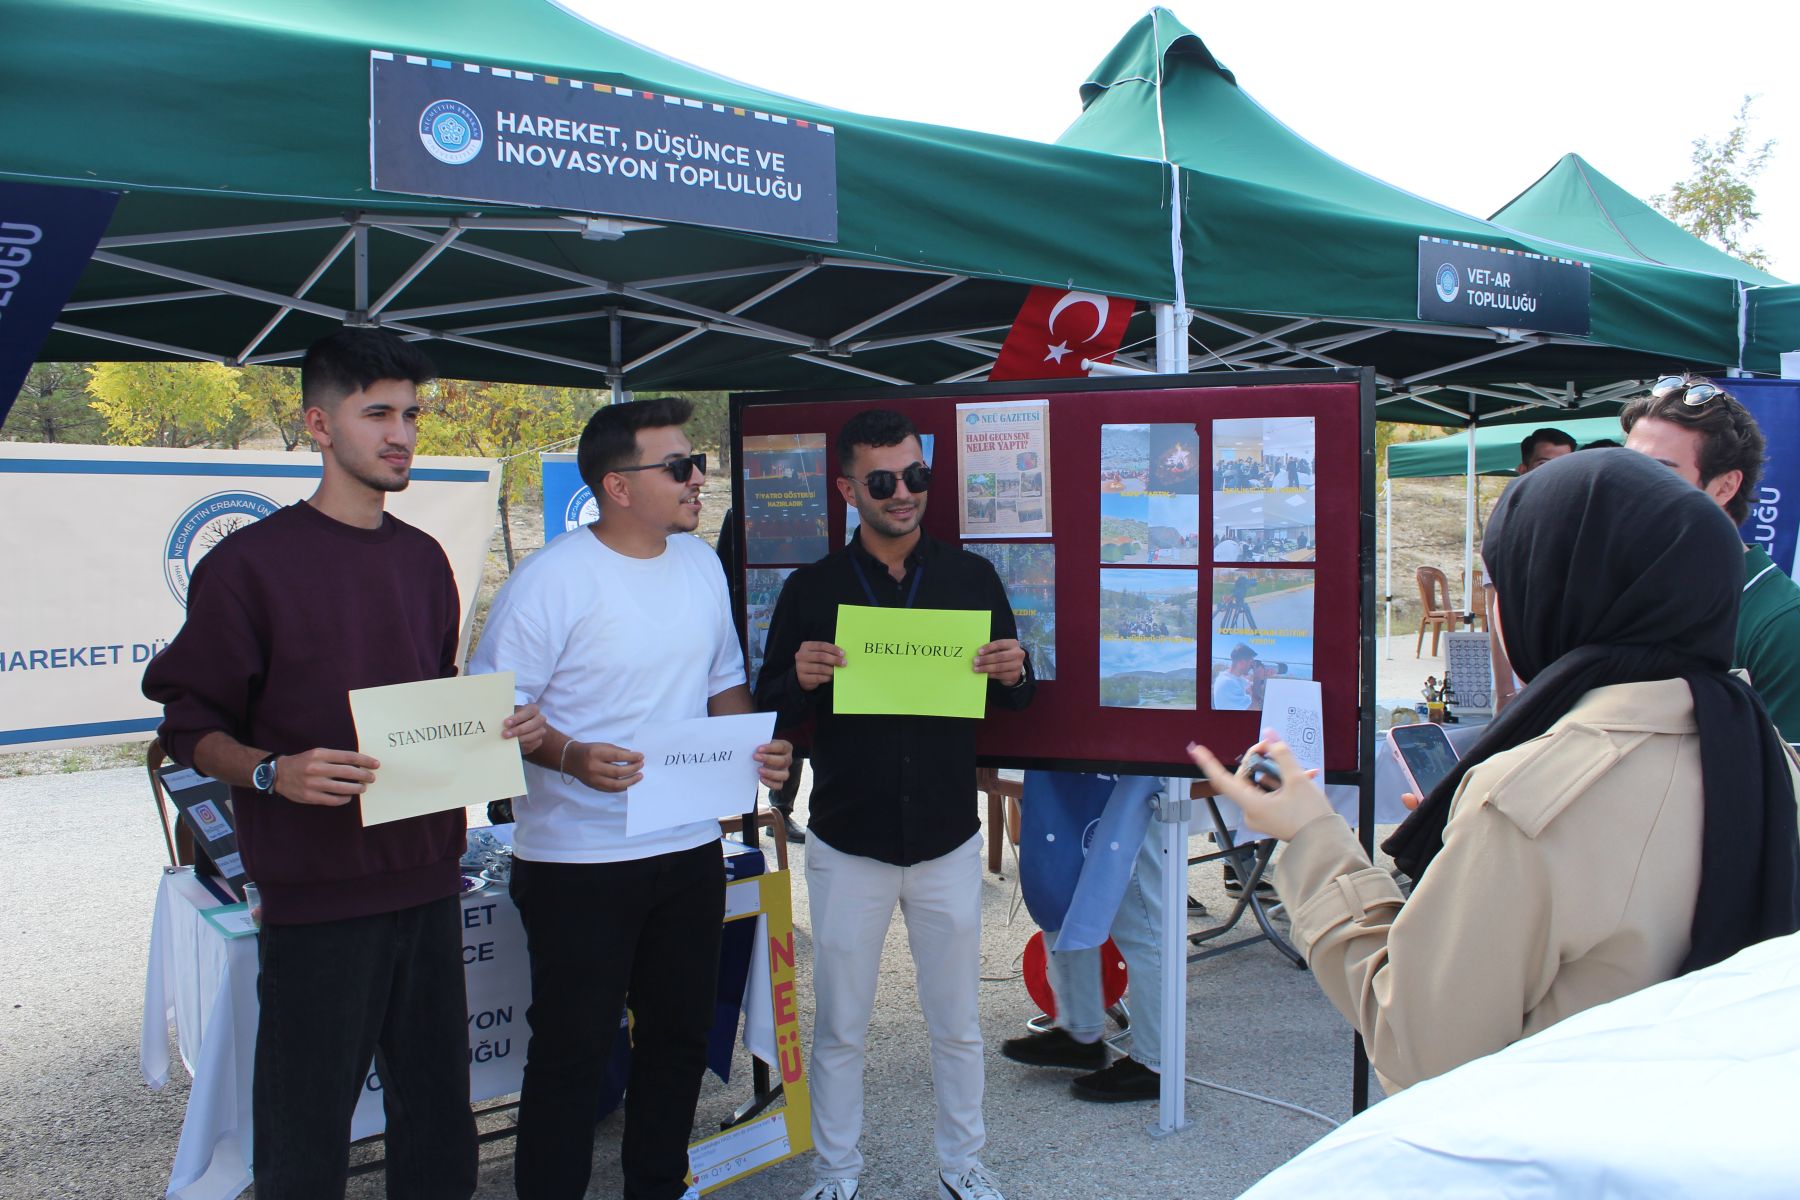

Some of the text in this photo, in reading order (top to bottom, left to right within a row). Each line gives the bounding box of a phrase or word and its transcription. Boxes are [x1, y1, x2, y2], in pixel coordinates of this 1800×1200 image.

[496, 110, 786, 173] HAREKET, DÜŞÜNCE VE
[497, 135, 802, 202] İNOVASYON TOPLULUĞU
[1466, 267, 1511, 288] VET-AR
[1466, 289, 1537, 313] TOPLULUĞU
[1000, 410, 1040, 423] GAZETESİ
[966, 431, 1030, 442] HADİ GEÇEN SENE
[966, 440, 1029, 453] NELER YAPTI?
[174, 508, 210, 557] NECMETTİN
[210, 499, 257, 513] ERBAKAN
[863, 641, 964, 659] BEKLİYORUZ
[387, 719, 487, 749] STANDIMIZA
[663, 749, 734, 767] DİVALARI
[769, 931, 802, 1084] NEÜ
